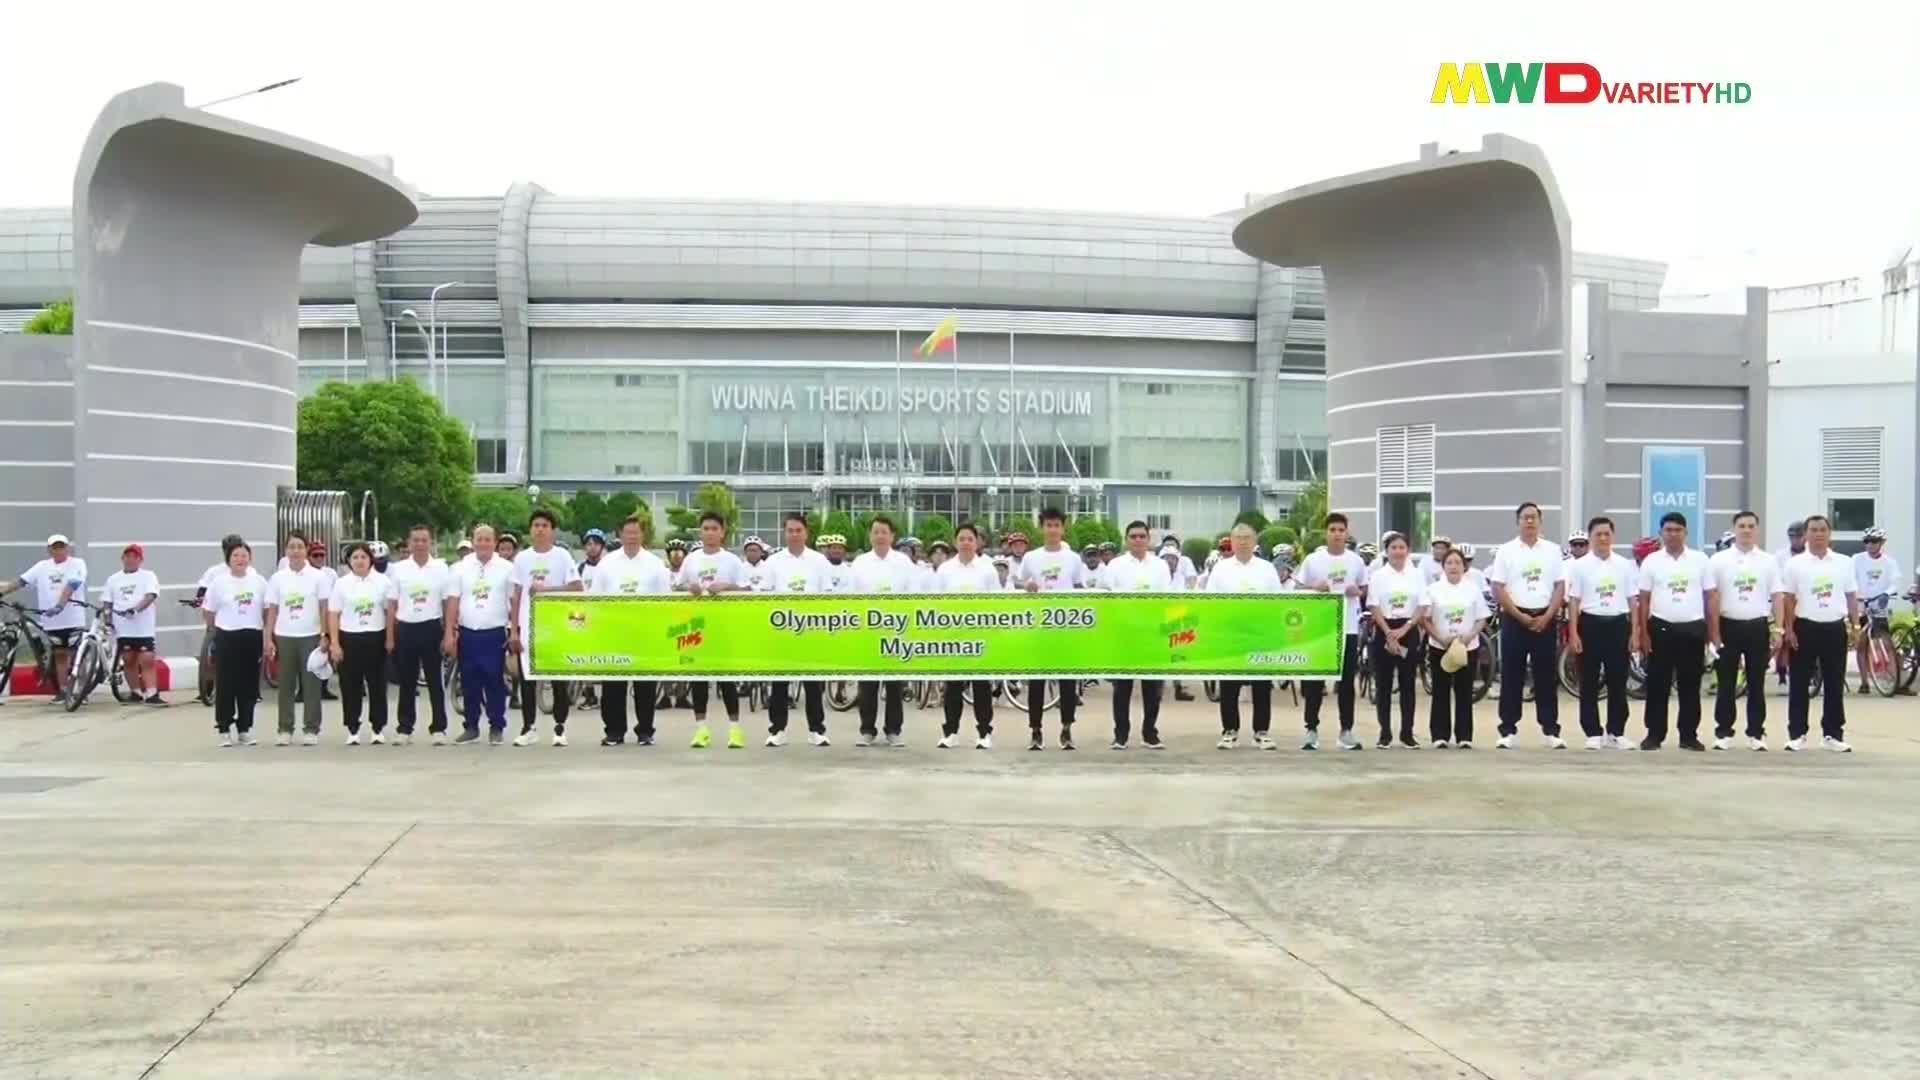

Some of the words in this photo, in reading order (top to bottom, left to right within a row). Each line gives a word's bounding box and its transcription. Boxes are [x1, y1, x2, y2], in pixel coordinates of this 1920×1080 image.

[711, 384, 796, 411] WUNNA
[807, 385, 891, 412] THEIKDI
[900, 387, 990, 413] SPORTS
[998, 389, 1092, 416] STADIUM
[1652, 492, 1697, 507] GATE
[769, 609, 862, 633] Olympic
[866, 609, 908, 632] Day
[914, 609, 1033, 628] Movement
[1039, 608, 1094, 627] 2026
[880, 637, 984, 660] Myanmar
